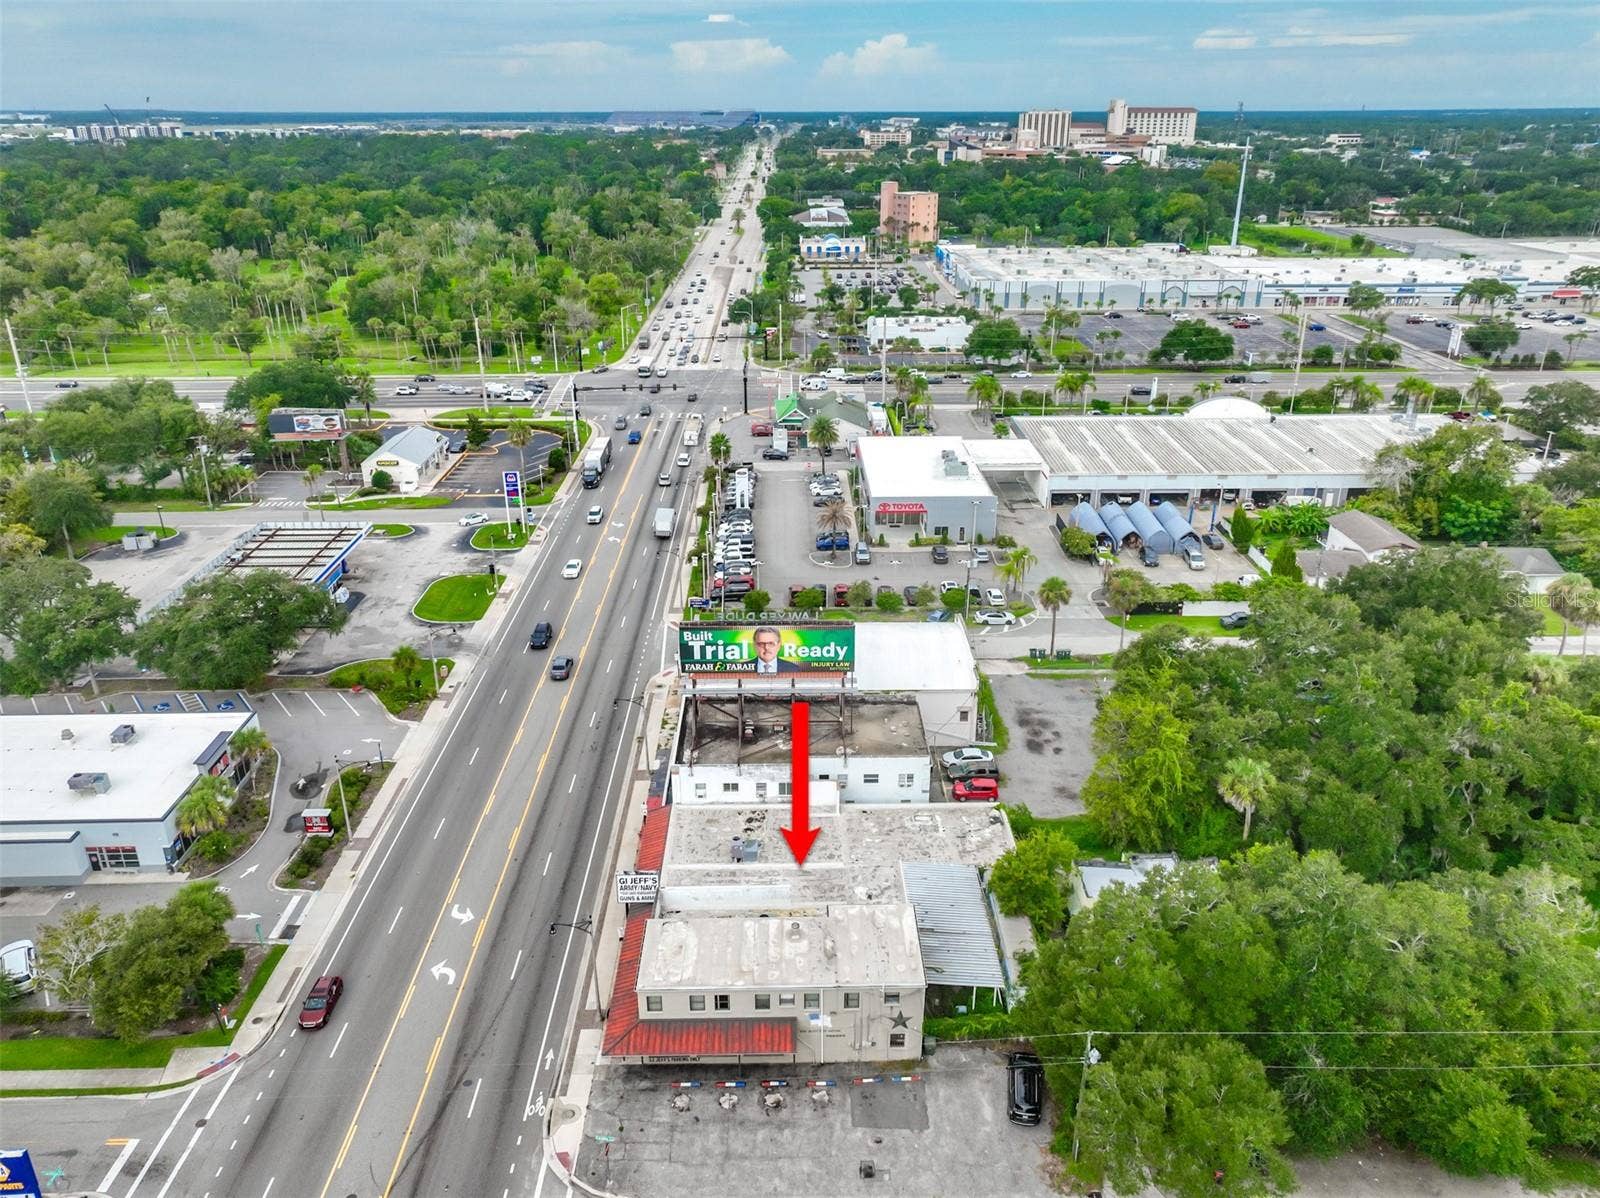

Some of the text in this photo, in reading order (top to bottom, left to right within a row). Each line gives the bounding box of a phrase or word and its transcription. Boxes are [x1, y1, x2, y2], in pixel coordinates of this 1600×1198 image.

[683, 631, 713, 641] Built
[688, 640, 848, 661] Trial Ready
[685, 663, 714, 671] FARAH
[726, 663, 756, 671] FARAH
